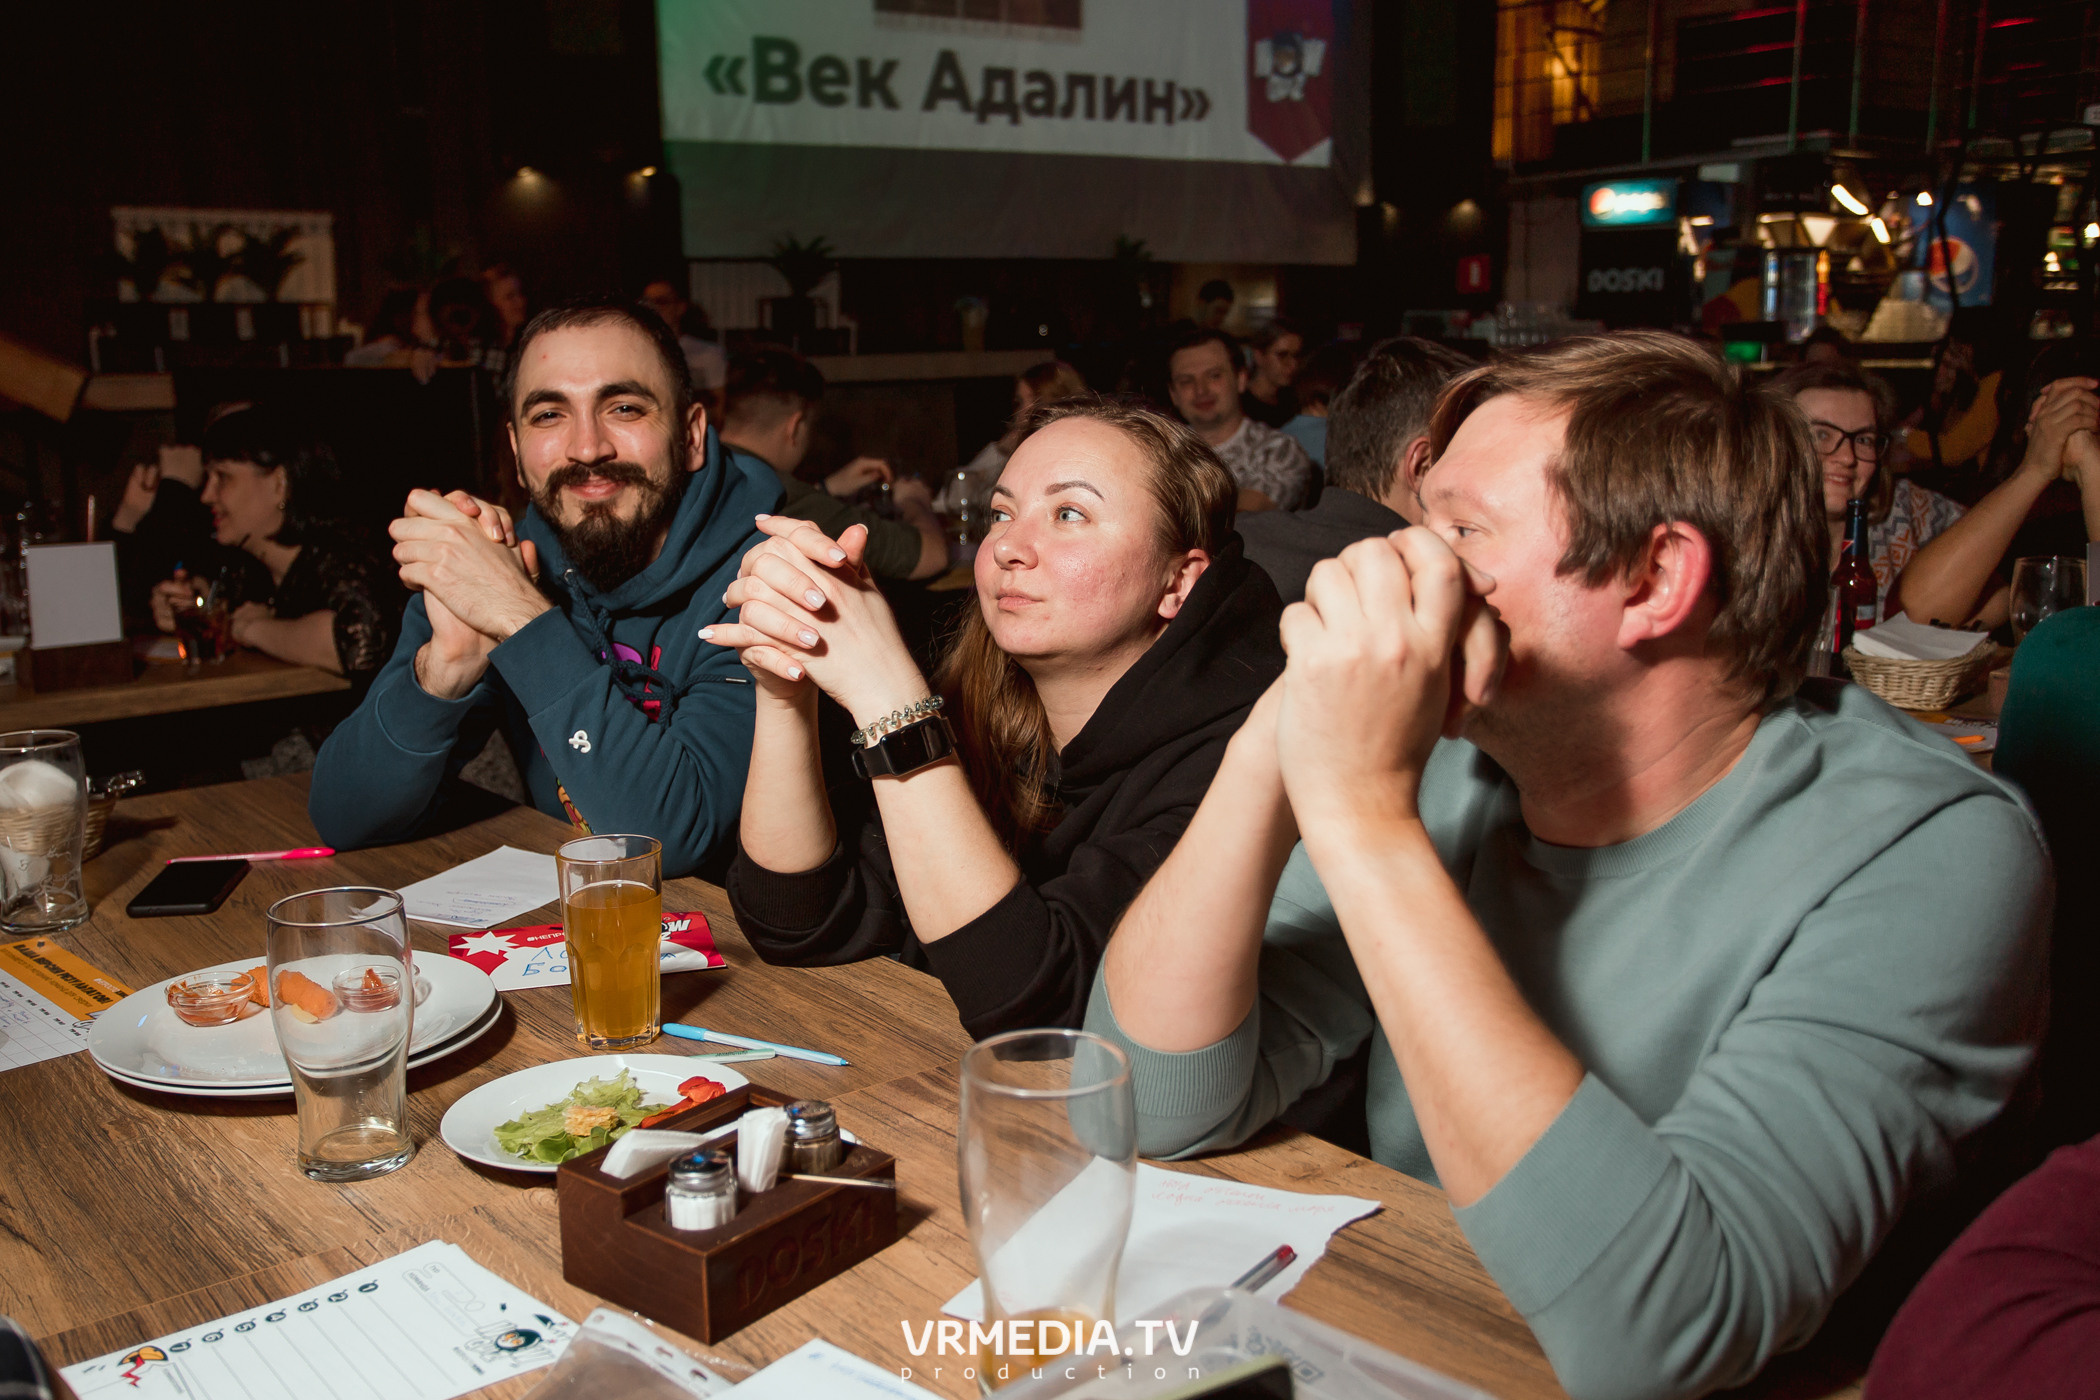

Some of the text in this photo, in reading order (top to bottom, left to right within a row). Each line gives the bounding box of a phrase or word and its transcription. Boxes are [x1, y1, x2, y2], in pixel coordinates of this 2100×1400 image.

[702, 34, 1211, 126] «Век Адалин»
[1586, 267, 1664, 293] DOSKI
[735, 1197, 875, 1312] DOSKI
